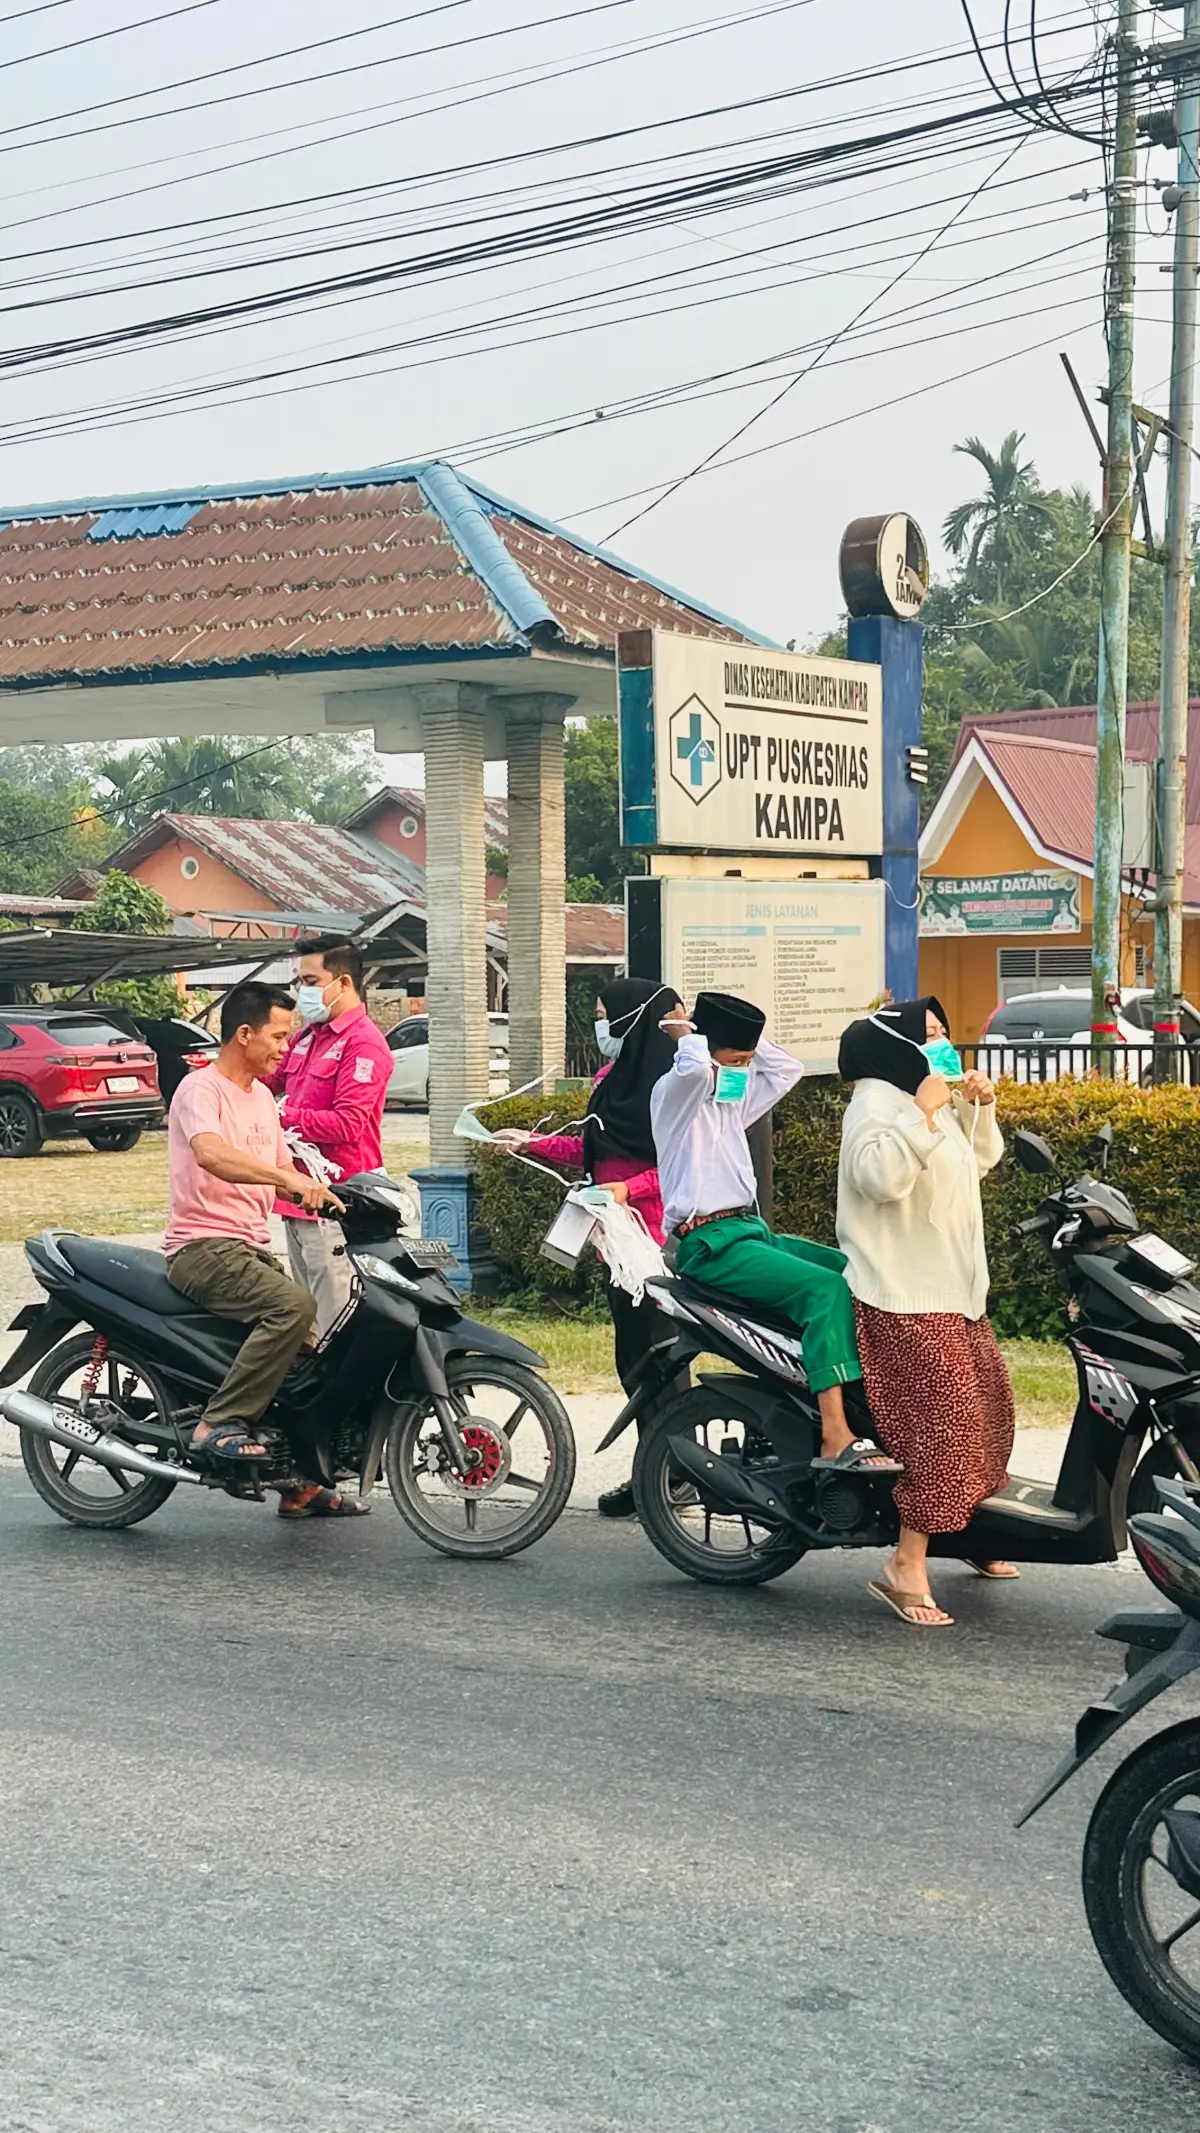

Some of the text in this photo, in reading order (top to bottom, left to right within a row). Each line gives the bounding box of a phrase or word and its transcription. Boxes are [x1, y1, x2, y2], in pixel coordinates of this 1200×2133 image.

[724, 661, 868, 712] DINAS KESEHATAN KABUPATEN KAMPAR
[725, 732, 868, 790] UPT PUSKESMAS
[755, 792, 845, 841] KAMPA
[936, 876, 1058, 895] SELAMAT DATANG
[745, 903, 818, 918] JENIS LAYANAN
